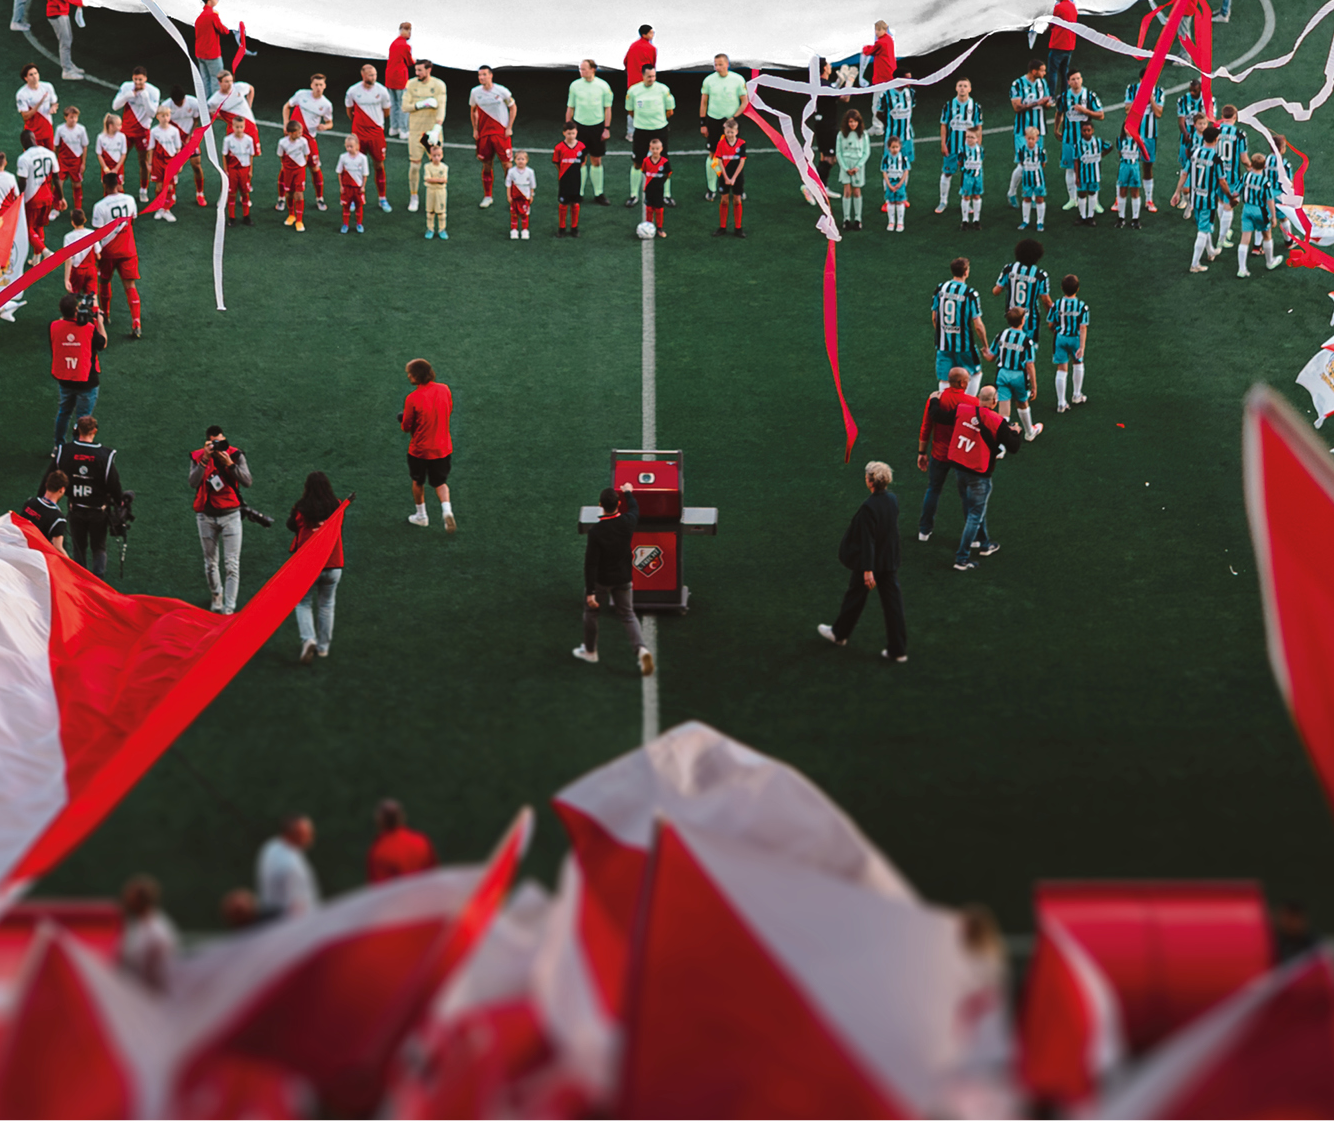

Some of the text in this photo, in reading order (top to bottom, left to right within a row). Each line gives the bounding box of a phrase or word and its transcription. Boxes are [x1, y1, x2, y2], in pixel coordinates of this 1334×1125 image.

[33, 157, 54, 179] 20
[1196, 164, 1206, 187] 7
[1015, 281, 1026, 305] 6
[944, 299, 956, 325] 9
[64, 357, 78, 369] TV
[957, 435, 976, 453] TV
